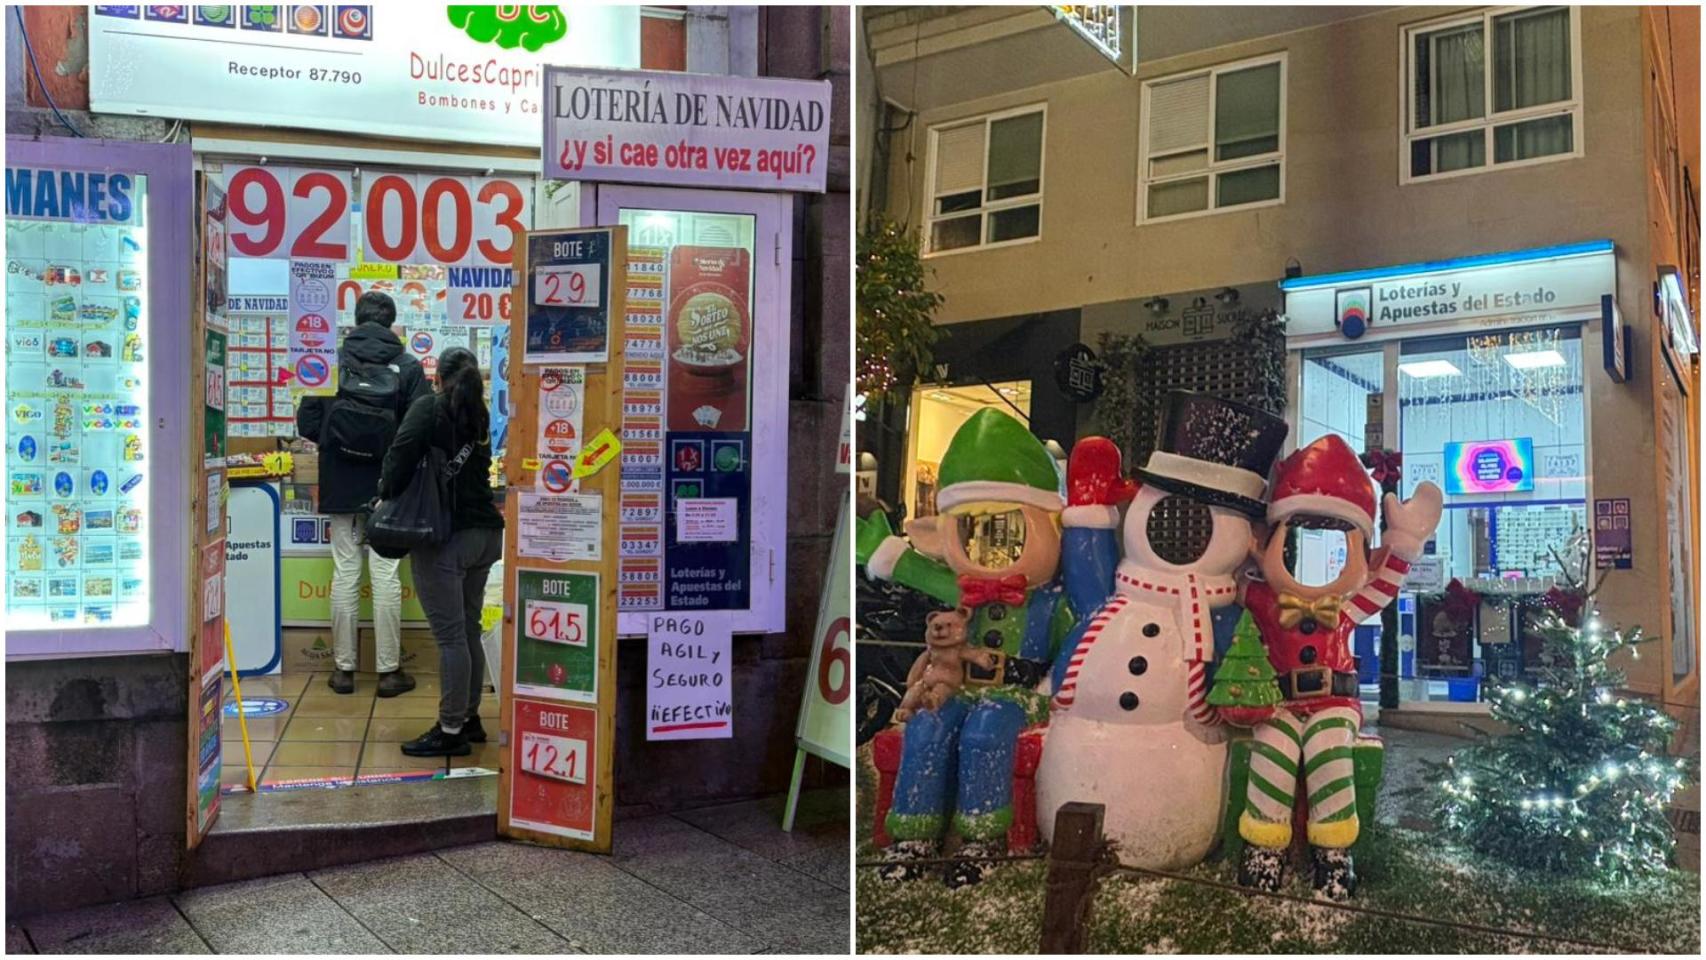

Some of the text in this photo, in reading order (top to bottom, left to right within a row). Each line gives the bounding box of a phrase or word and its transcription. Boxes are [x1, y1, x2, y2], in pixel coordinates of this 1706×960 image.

[228, 61, 362, 85] Receptor 87.790
[418, 91, 496, 110] Bombones
[505, 101, 511, 114] y
[554, 80, 824, 132] LOTERÍA DE NAVIDAD
[560, 134, 816, 181] ¿y si cae otra vez aquí?
[5, 168, 131, 222] MANES
[553, 240, 583, 258] BOTE
[1379, 281, 1461, 302] Loterías y
[228, 298, 242, 310] DE
[463, 292, 492, 320] 20
[1380, 301, 1457, 322] Apuestas
[1463, 293, 1488, 312] del
[1494, 287, 1556, 308] Estado
[301, 316, 322, 328] +18
[550, 423, 569, 433] +18
[225, 541, 271, 551] Apuestas
[670, 567, 726, 580] Loterías y
[542, 579, 571, 596] BOTE
[671, 580, 742, 594] Apuestas del
[670, 595, 709, 606] Estado
[654, 616, 704, 636] PAGO
[661, 641, 707, 659] AGIL
[652, 668, 724, 689] SEGURO
[539, 711, 569, 730] BOTE
